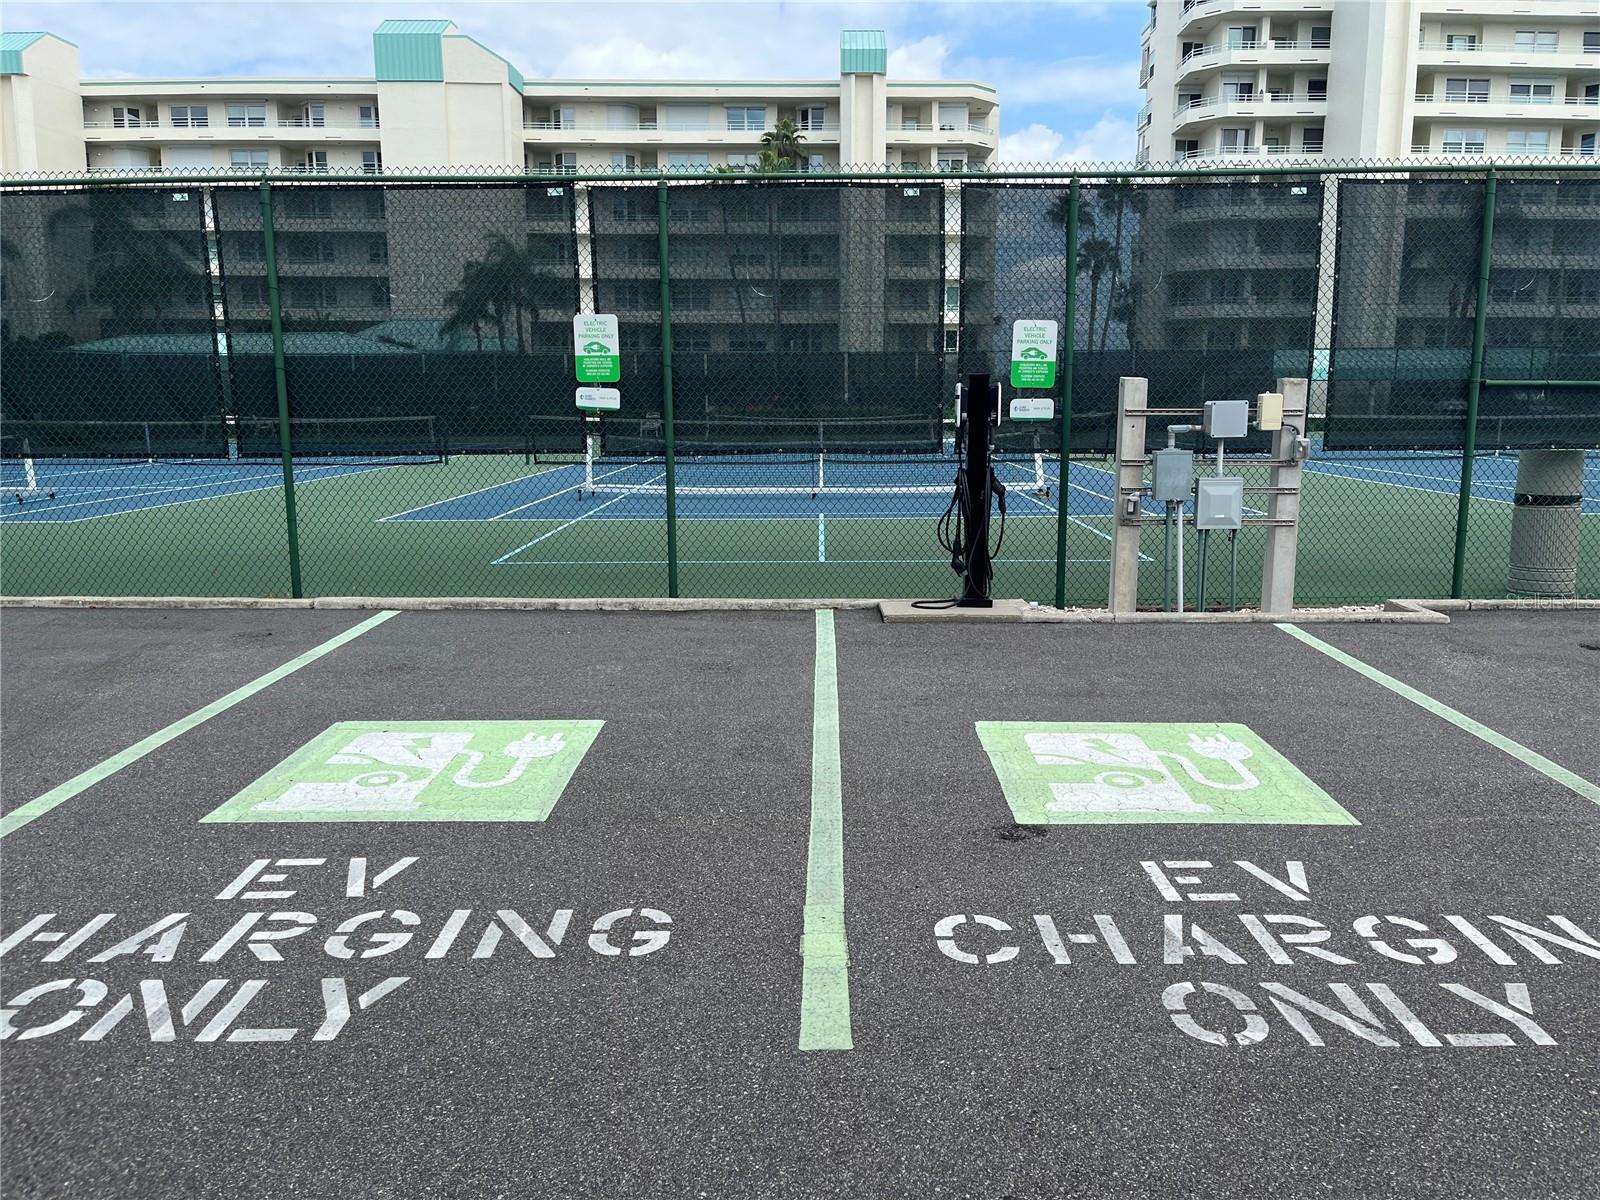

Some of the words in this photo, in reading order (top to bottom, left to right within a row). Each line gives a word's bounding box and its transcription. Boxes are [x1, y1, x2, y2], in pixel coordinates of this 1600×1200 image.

[215, 856, 420, 900] EV
[1139, 859, 1311, 902] EV
[0, 976, 410, 1043] ONLY
[1161, 980, 1558, 1048] ONLY
